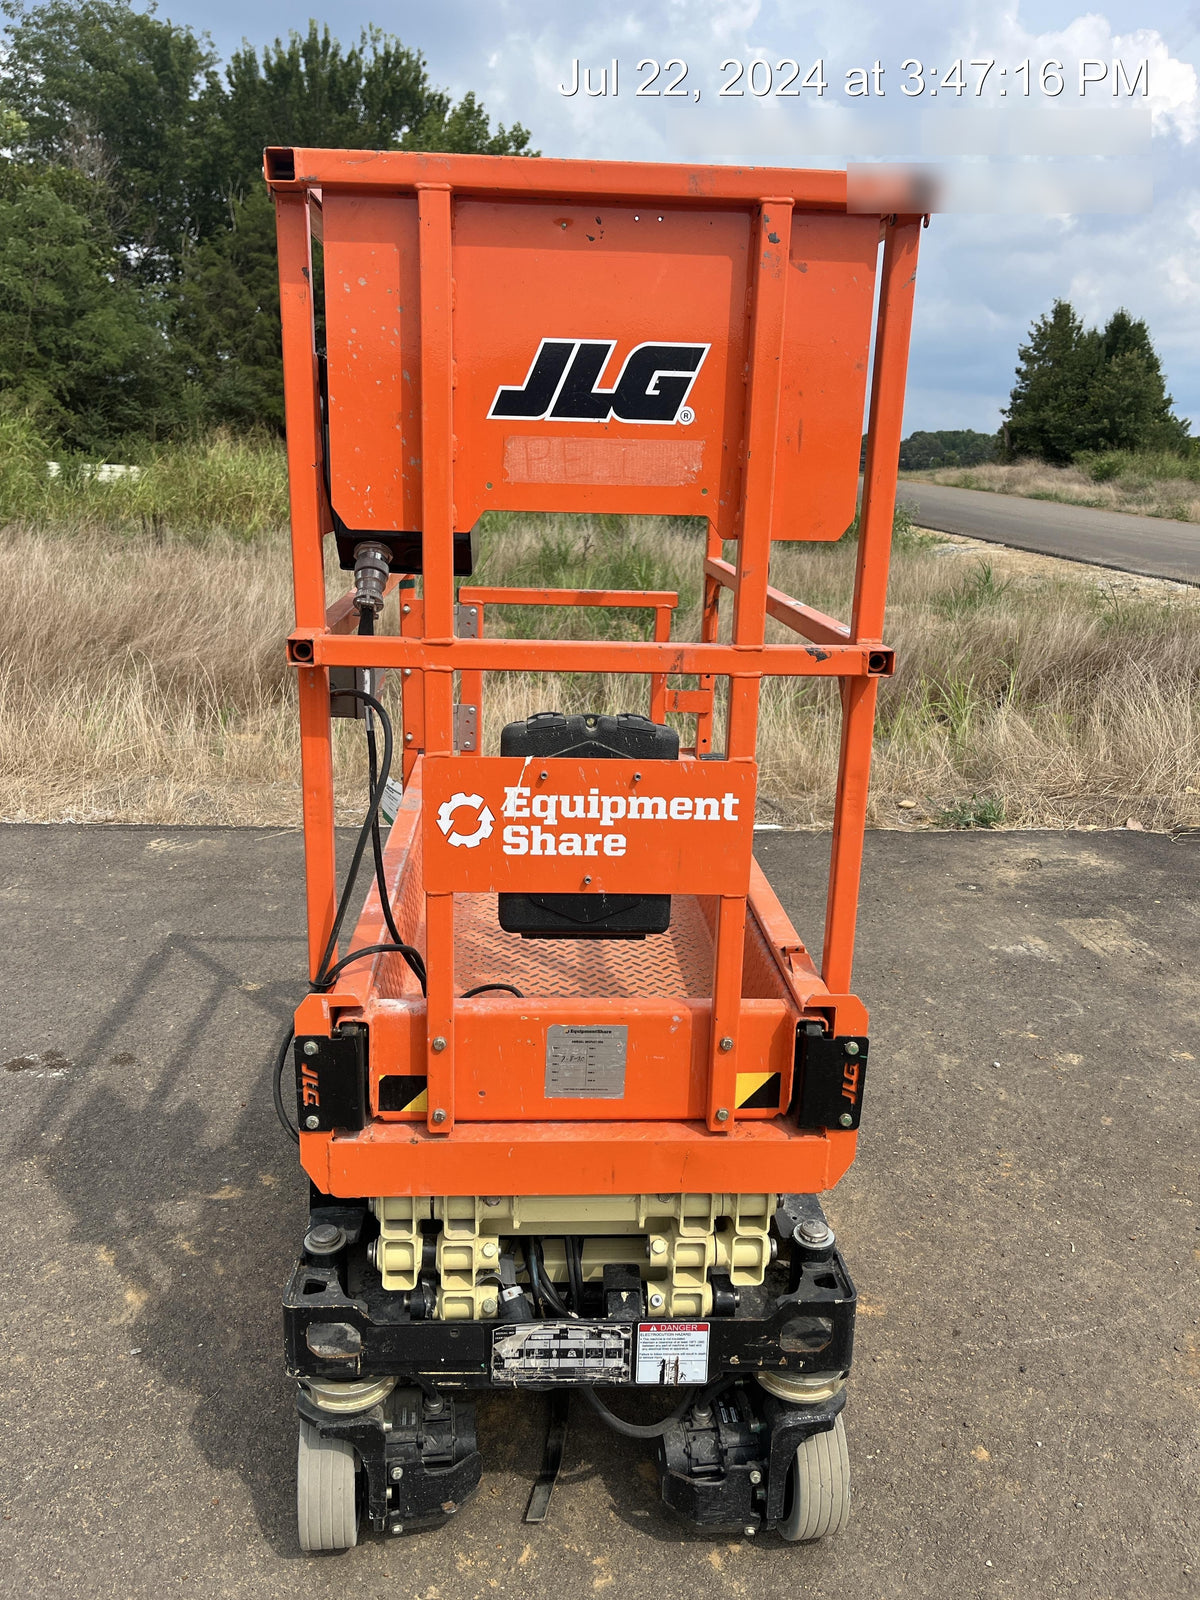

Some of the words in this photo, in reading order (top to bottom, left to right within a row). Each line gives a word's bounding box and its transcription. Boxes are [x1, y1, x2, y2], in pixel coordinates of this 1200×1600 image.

[486, 337, 712, 425] JLG
[503, 786, 739, 826] Equipment
[502, 825, 627, 857] Share
[841, 1062, 860, 1105] JLG
